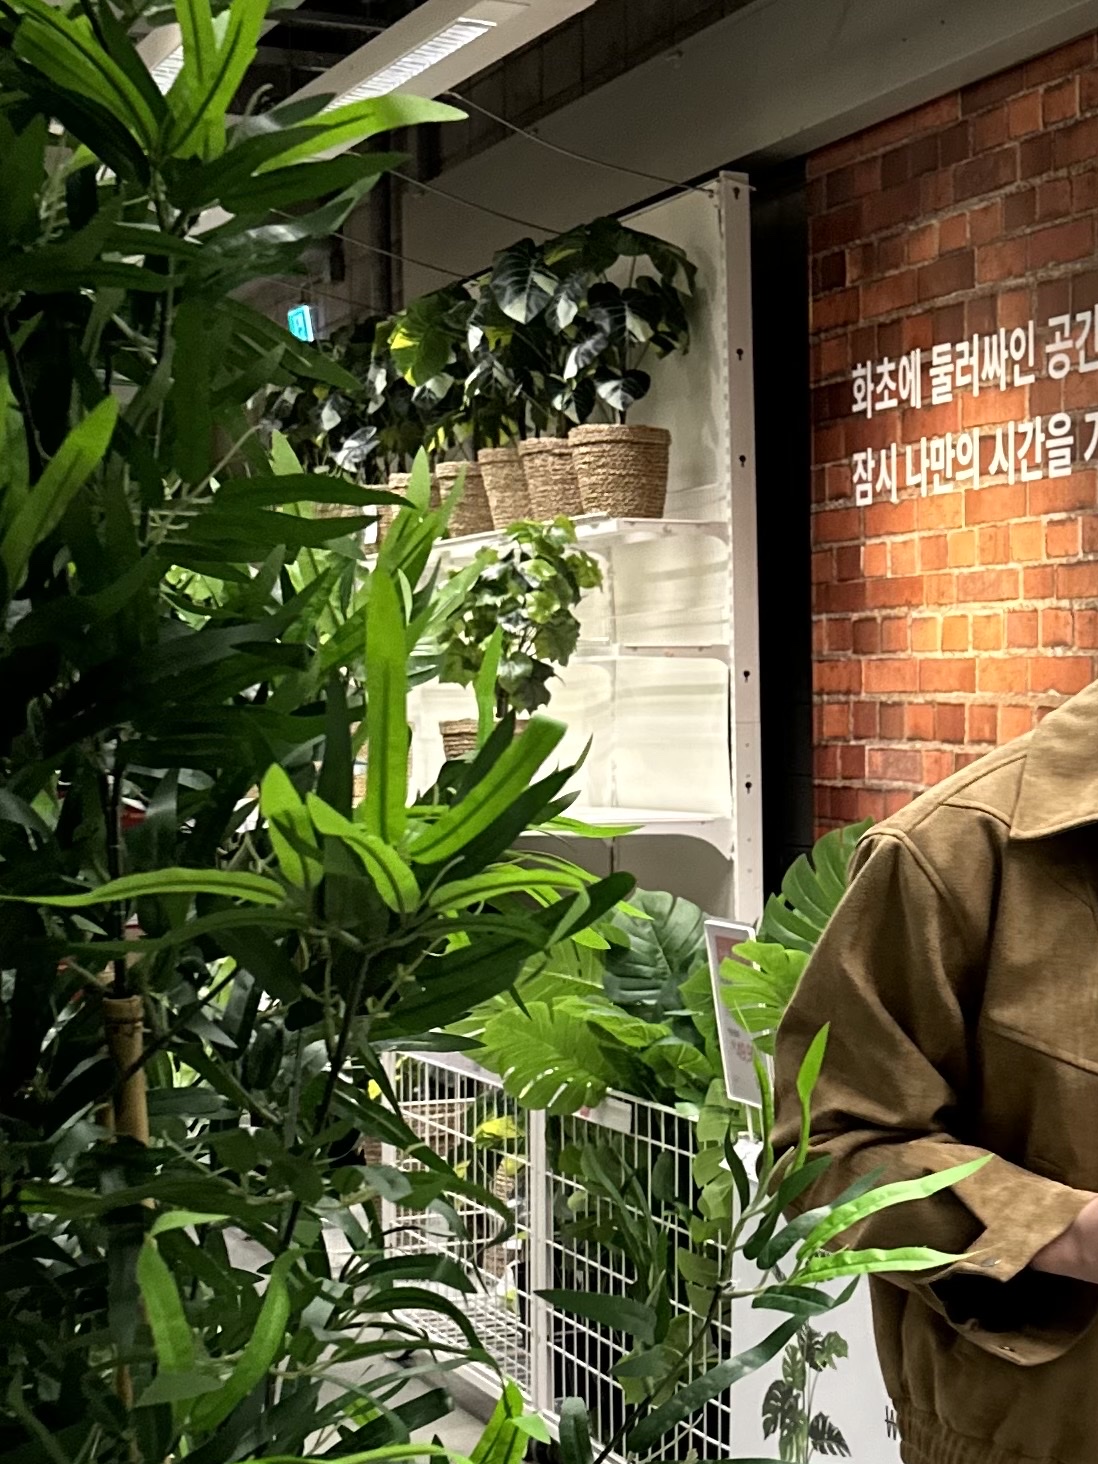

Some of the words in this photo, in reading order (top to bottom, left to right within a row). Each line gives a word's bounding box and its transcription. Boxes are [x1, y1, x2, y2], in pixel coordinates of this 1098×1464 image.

[851, 348, 921, 419] 화초에
[929, 320, 1035, 406] 둘러싸인
[852, 442, 898, 507] 잠시
[905, 427, 980, 498] 나만의
[988, 412, 1073, 485] 시간을
